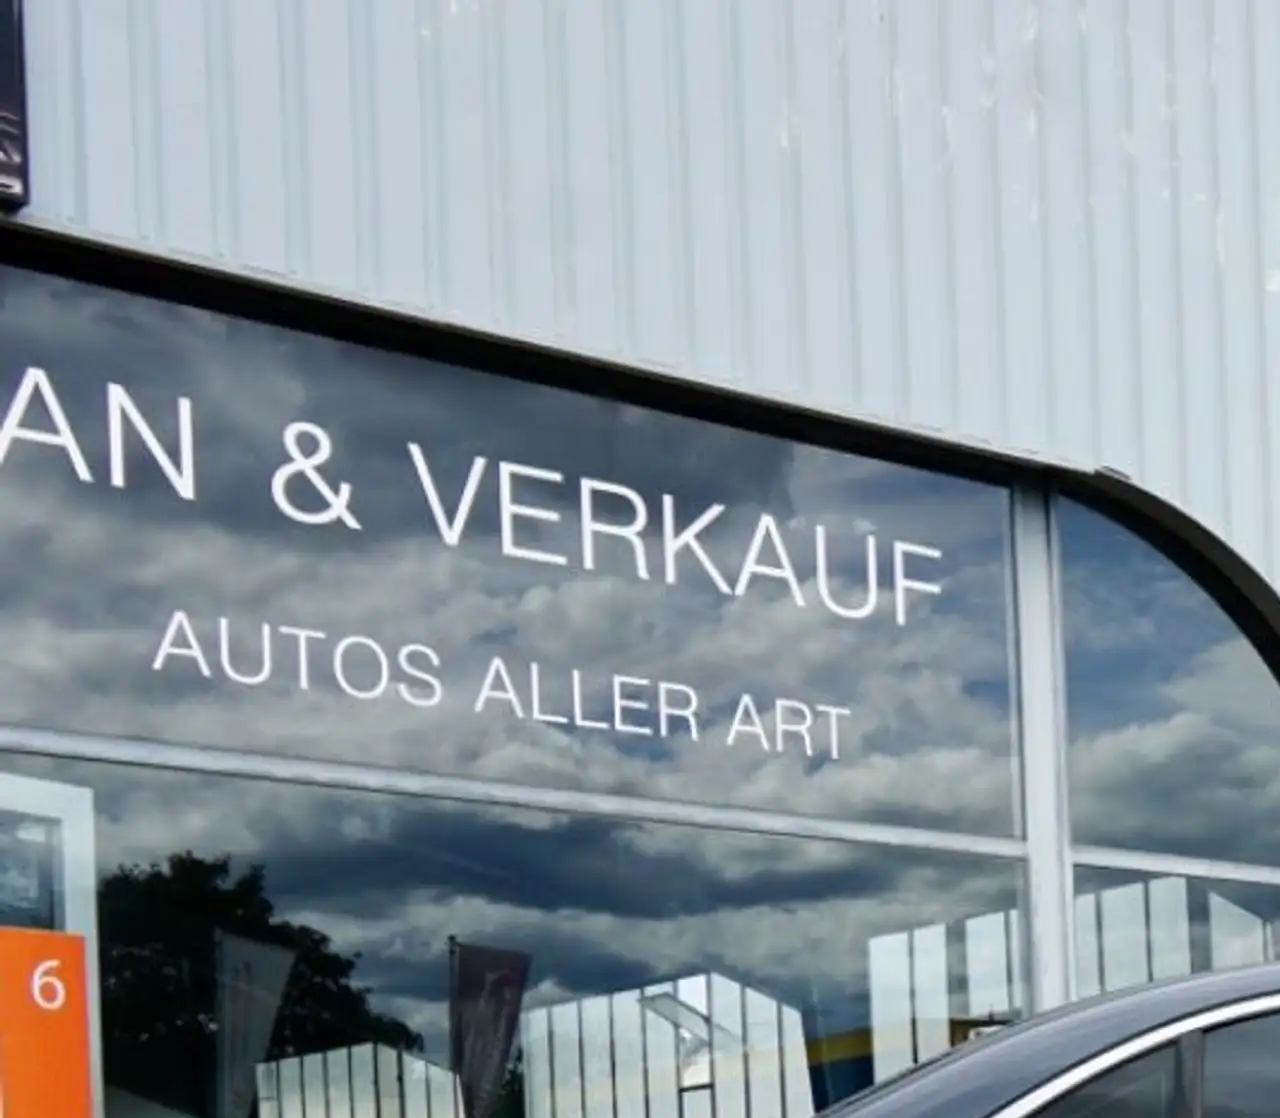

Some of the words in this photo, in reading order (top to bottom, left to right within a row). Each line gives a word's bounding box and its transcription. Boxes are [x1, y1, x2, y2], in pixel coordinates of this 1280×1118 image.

[0, 366, 195, 500] AN
[270, 421, 362, 530] &
[407, 442, 943, 626] VERKAUF
[151, 610, 443, 708] AUTOS
[473, 657, 699, 741] ALLER
[726, 693, 851, 760] ART
[32, 959, 66, 1010] 6
